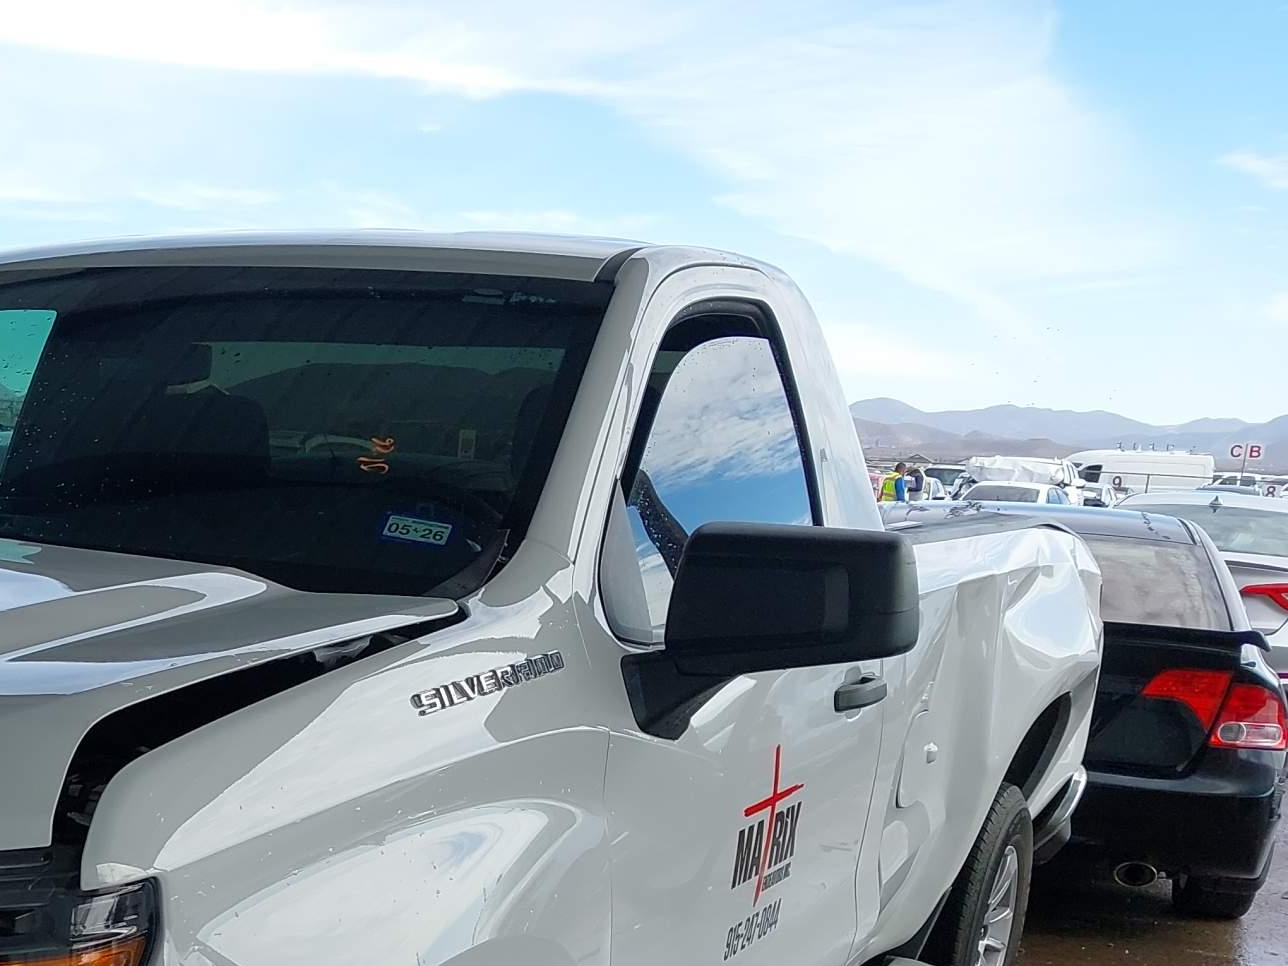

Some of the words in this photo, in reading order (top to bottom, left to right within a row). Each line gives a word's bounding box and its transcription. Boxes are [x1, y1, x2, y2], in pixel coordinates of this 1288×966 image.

[1230, 444, 1242, 458] C
[1249, 445, 1262, 459] B
[1112, 475, 1122, 488] 9
[387, 522, 412, 536] 05
[419, 528, 445, 542] 26
[410, 650, 564, 717] SILVERADO
[723, 897, 782, 961] 915-247-0844
